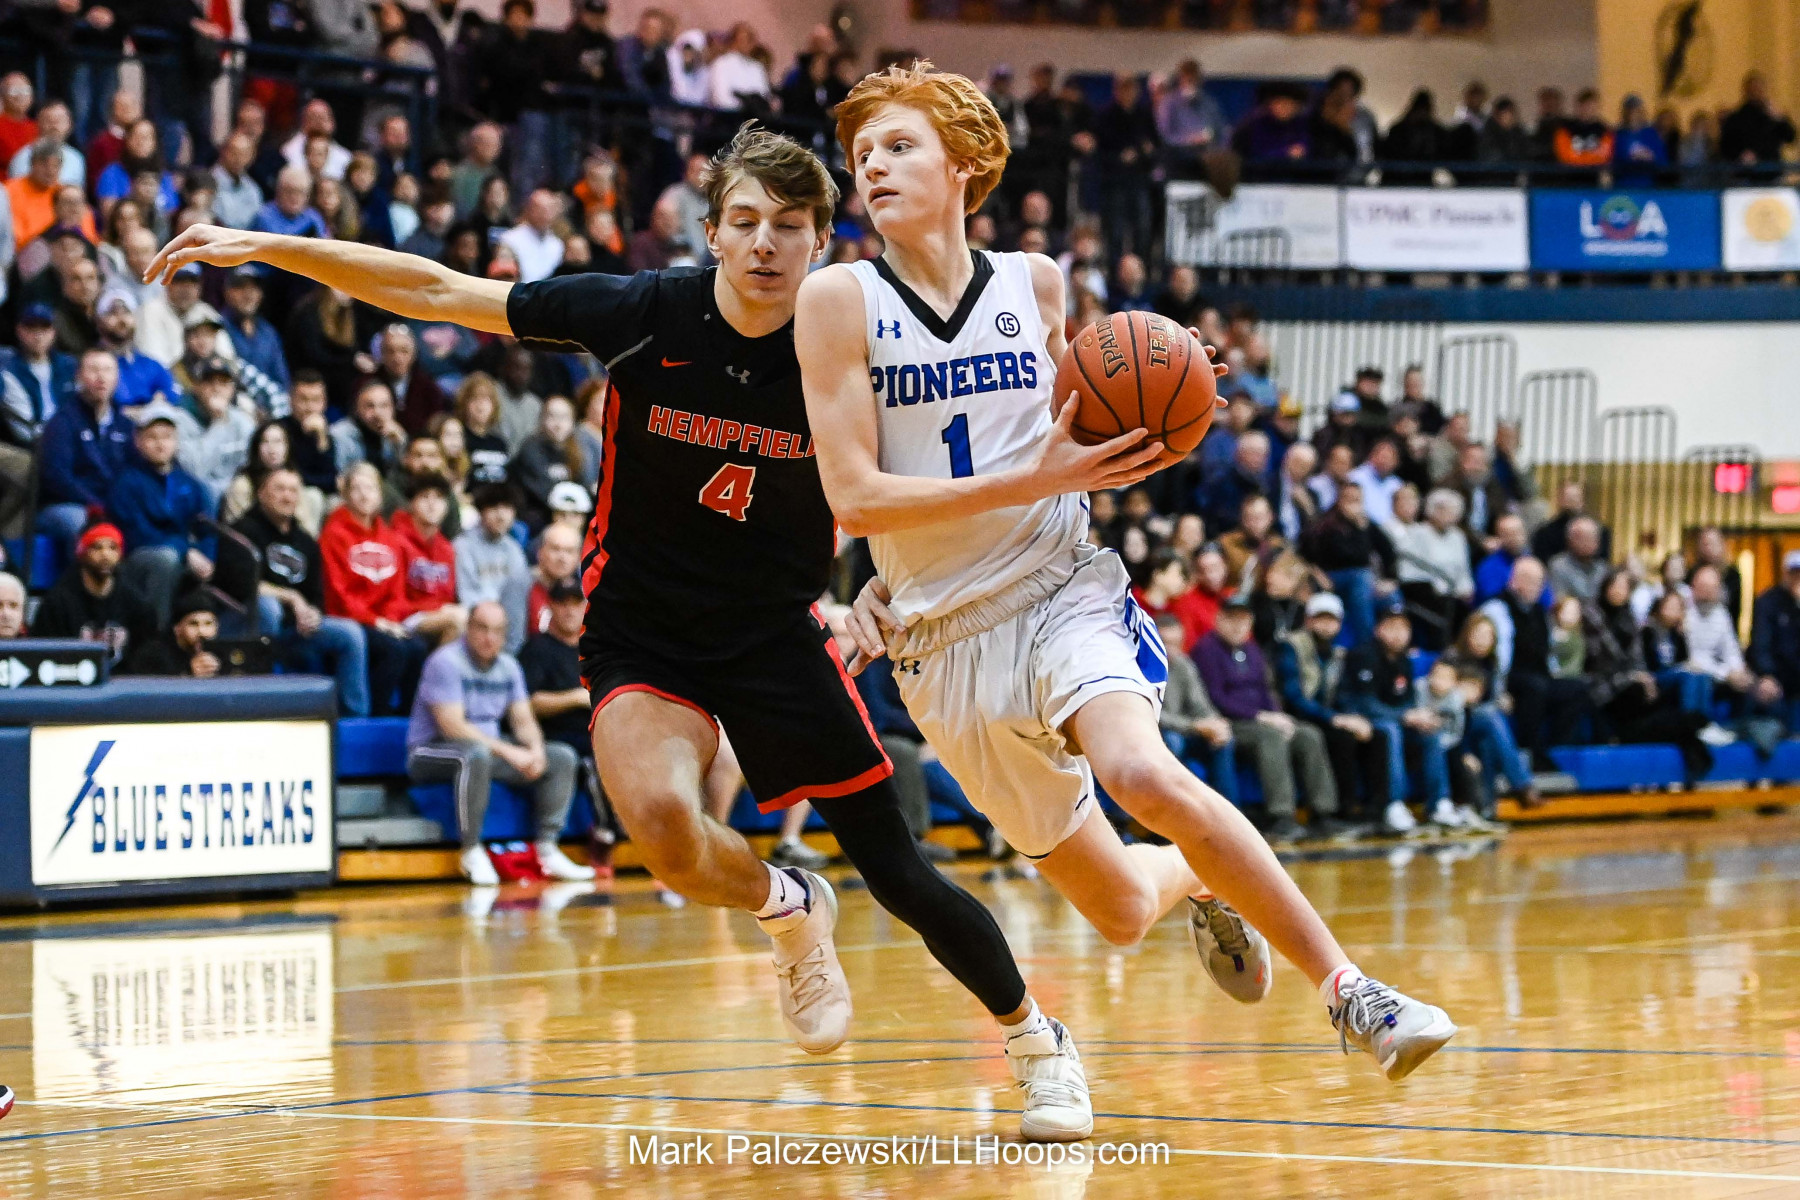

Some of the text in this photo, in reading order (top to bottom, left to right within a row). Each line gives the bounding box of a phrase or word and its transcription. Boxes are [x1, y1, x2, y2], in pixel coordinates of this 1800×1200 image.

[1001, 317, 1015, 331] 15
[871, 352, 1037, 408] PIONEERS
[941, 413, 974, 478] 1
[698, 463, 757, 522] 4
[91, 780, 313, 853] BLUE STREAKS
